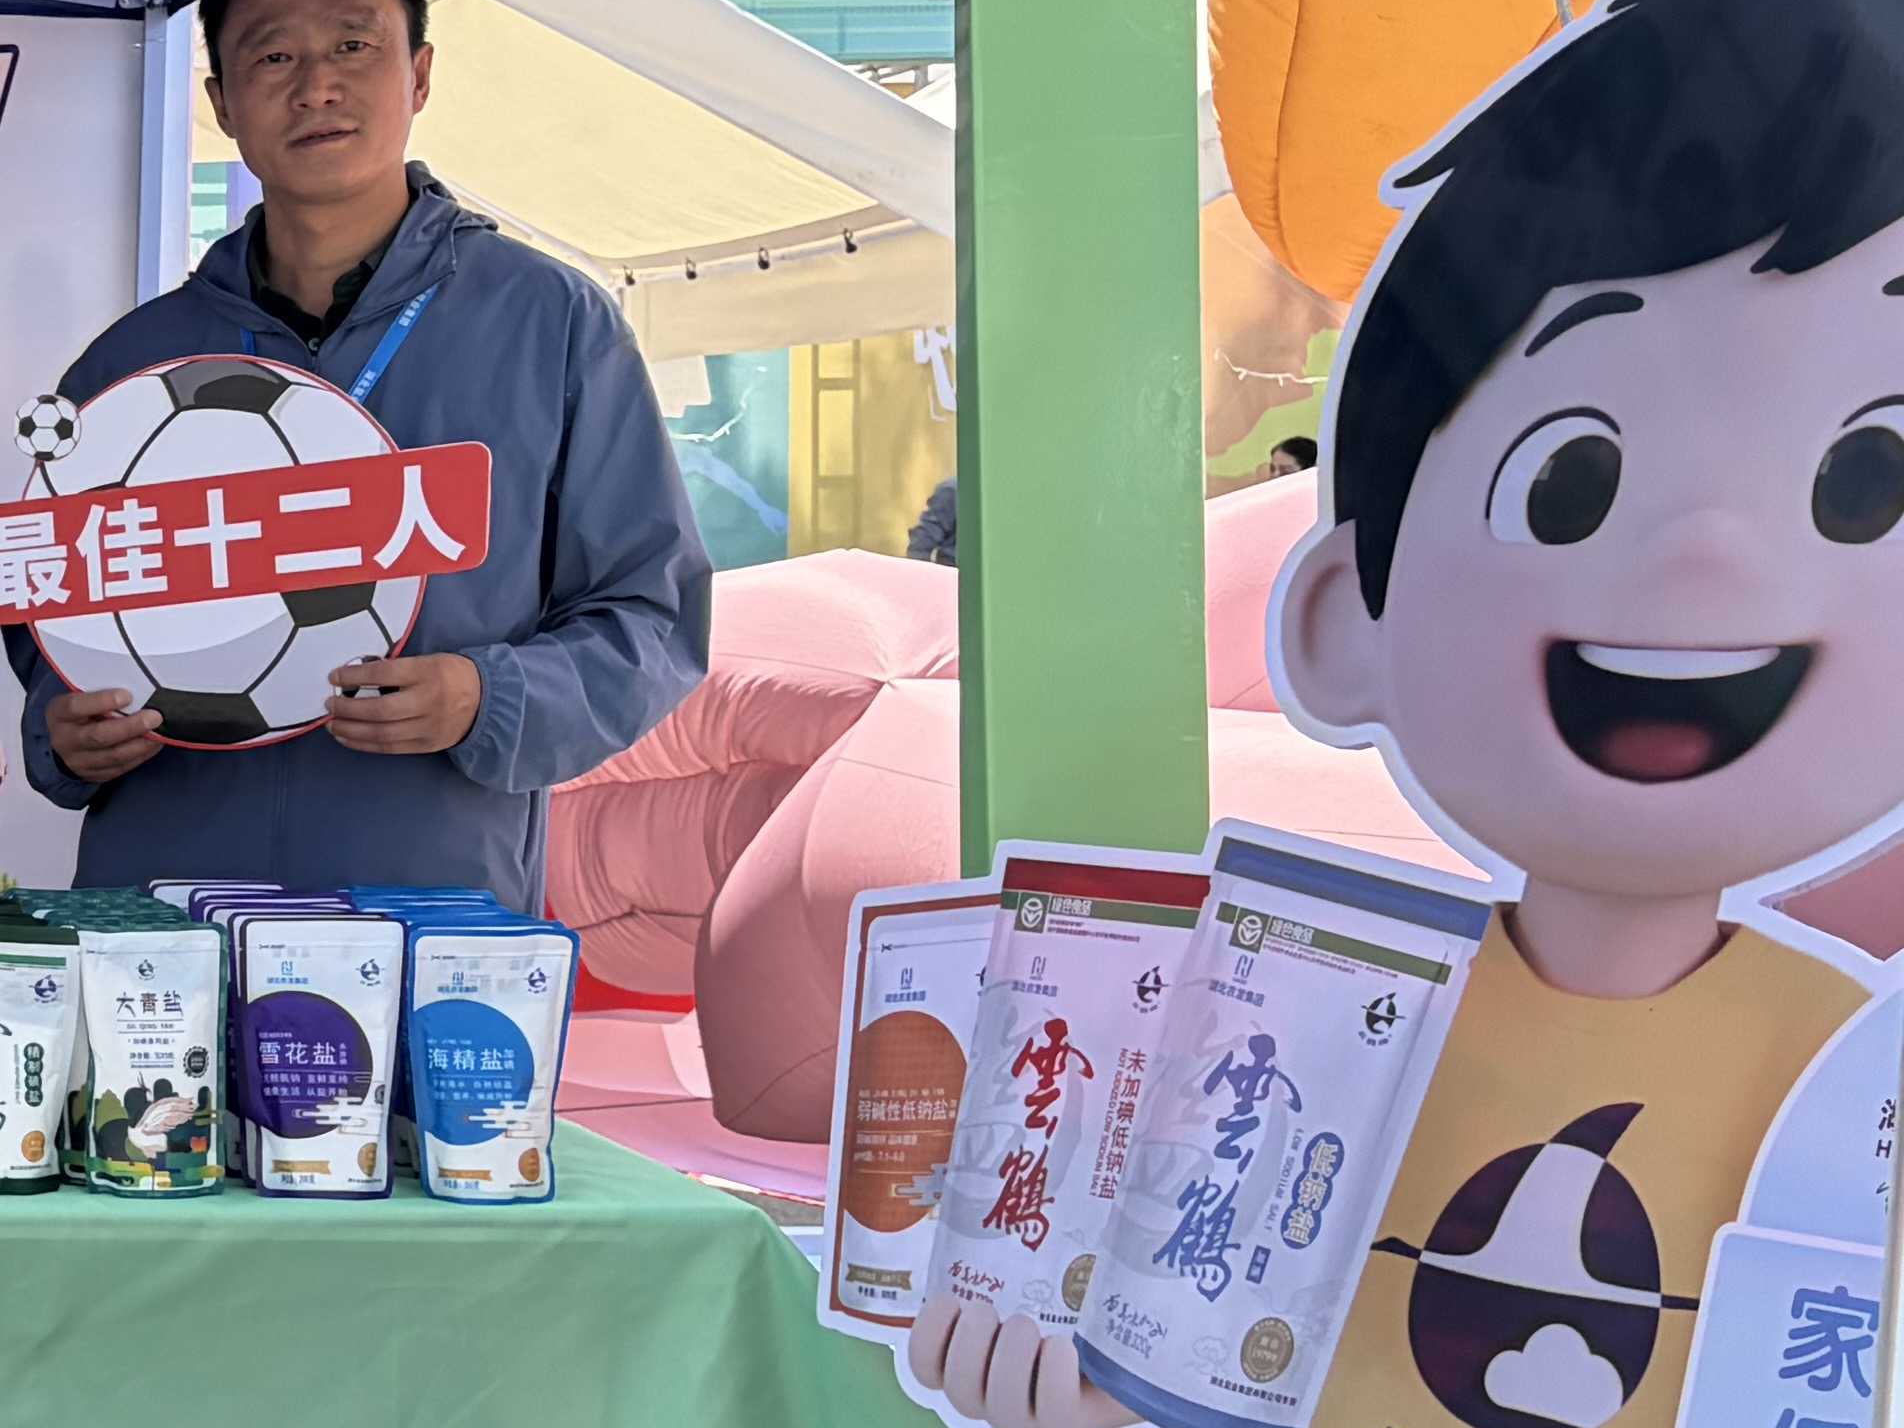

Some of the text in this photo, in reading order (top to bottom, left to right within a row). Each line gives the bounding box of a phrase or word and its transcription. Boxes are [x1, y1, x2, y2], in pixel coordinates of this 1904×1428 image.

[116, 990, 184, 1017] 大青盐
[259, 1041, 337, 1066] 雪花盐
[427, 1047, 504, 1072] 海精盐
[857, 1098, 949, 1122] 弱碱性低钠盐
[982, 1017, 1094, 1253] 雲鶴
[1098, 1048, 1147, 1201] 未加碘低钠盐
[1152, 1032, 1303, 1303] 雲鶴
[1282, 1135, 1342, 1246] 低钠盐
[1778, 1285, 1880, 1398] 家
